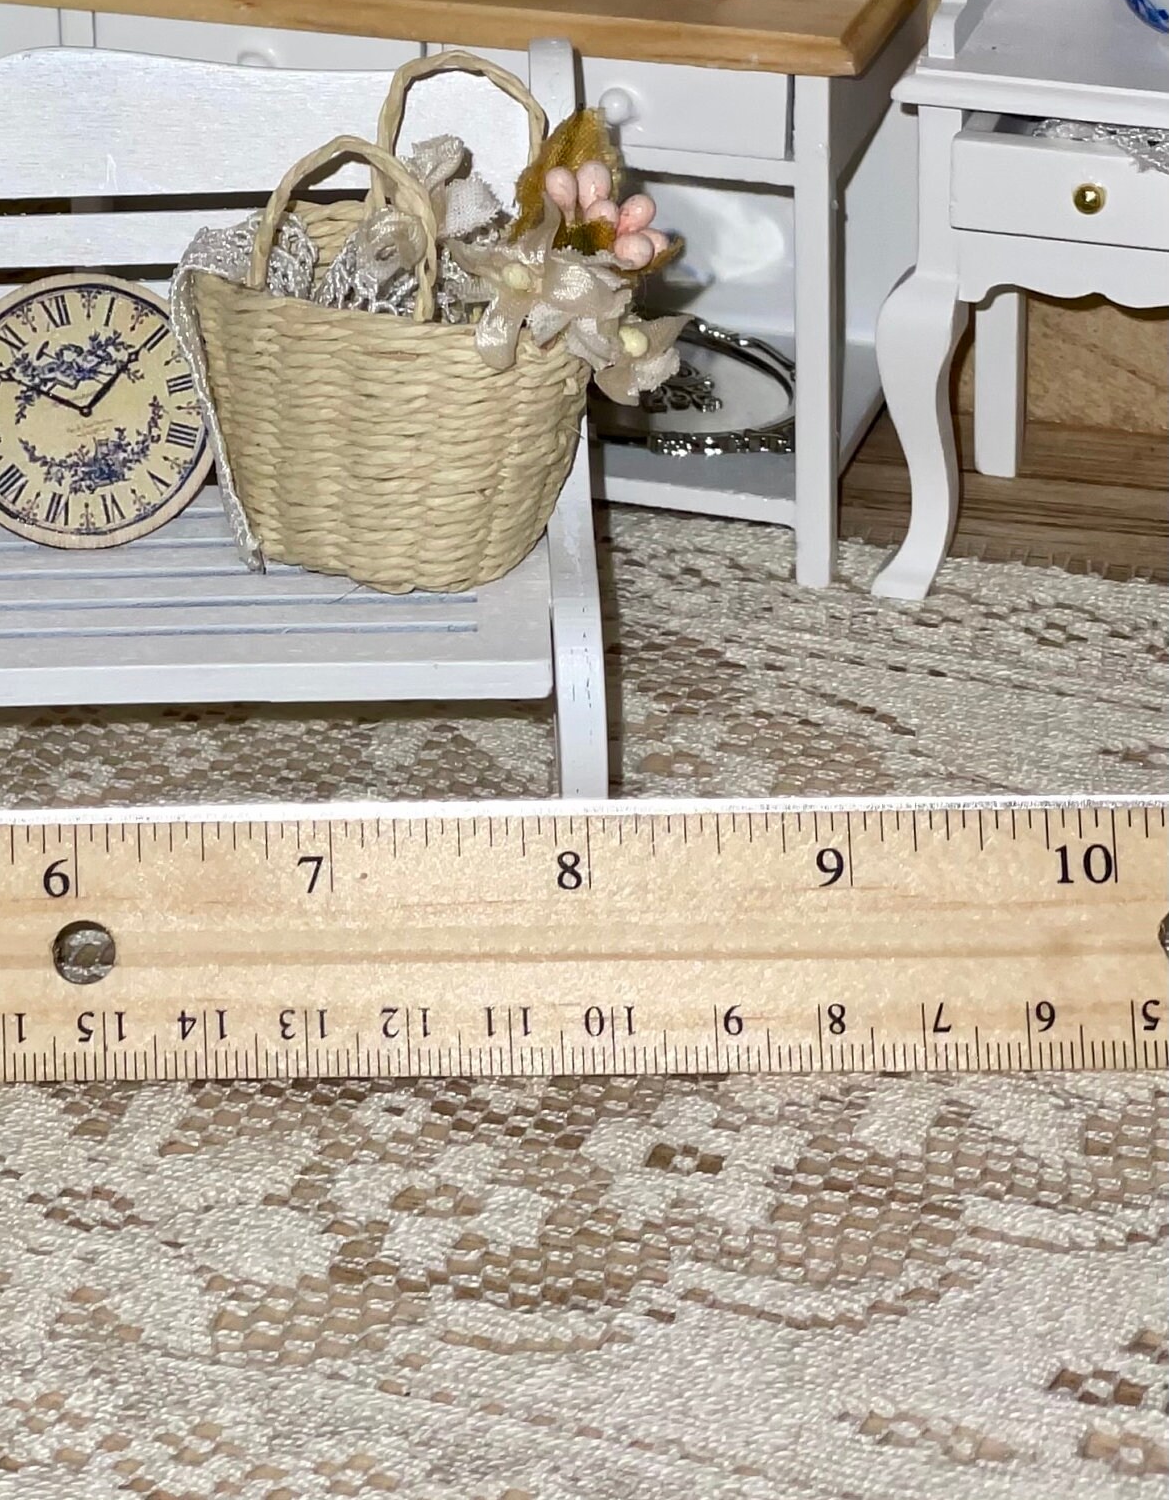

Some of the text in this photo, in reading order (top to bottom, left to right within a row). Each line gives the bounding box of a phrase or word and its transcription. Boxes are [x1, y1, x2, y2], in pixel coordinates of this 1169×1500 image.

[42, 858, 71, 898] 6
[297, 856, 323, 893] 7
[557, 851, 583, 890] 8
[816, 848, 845, 886] 9
[1055, 843, 1113, 884] 10
